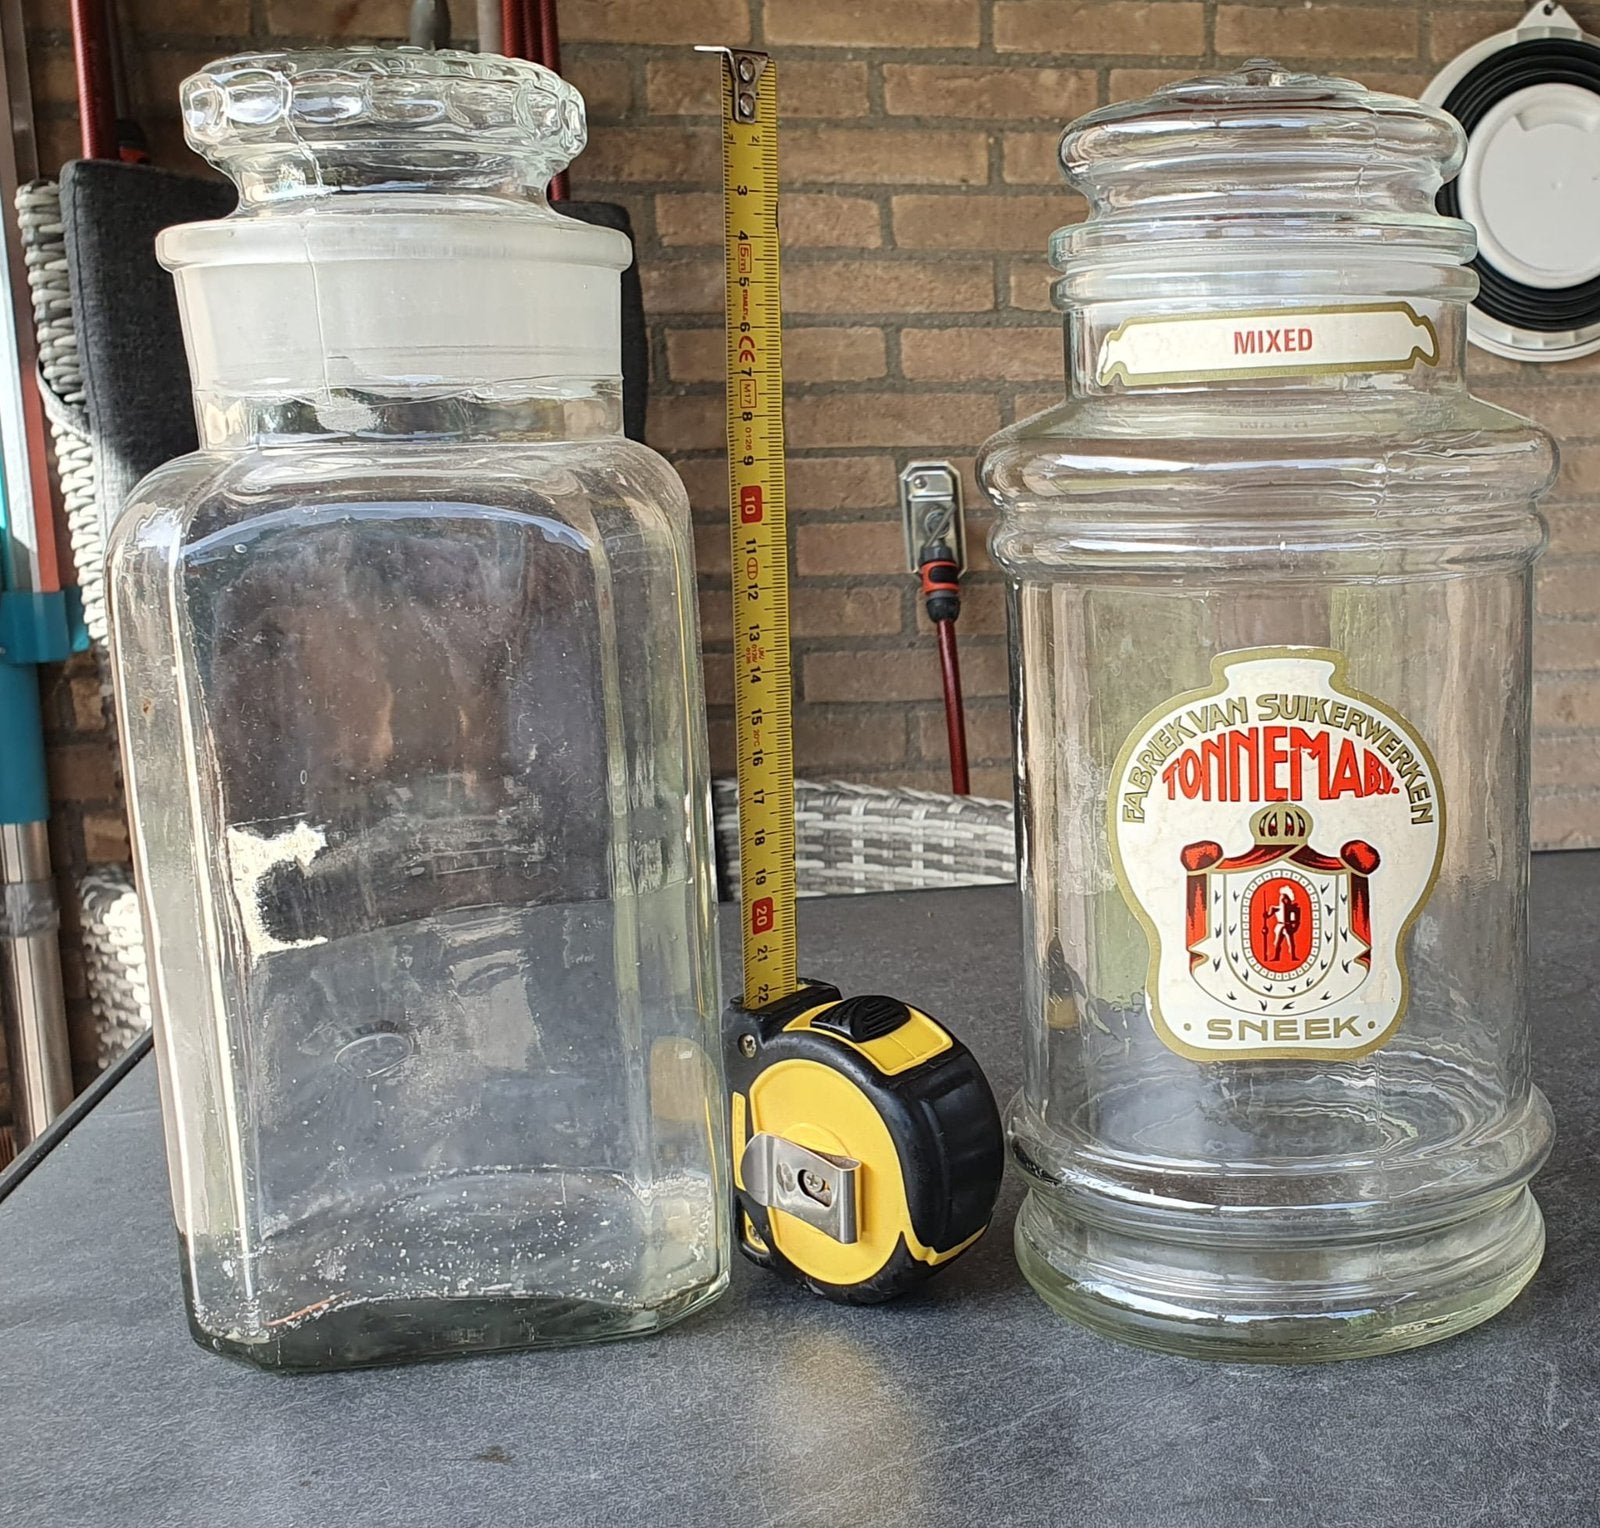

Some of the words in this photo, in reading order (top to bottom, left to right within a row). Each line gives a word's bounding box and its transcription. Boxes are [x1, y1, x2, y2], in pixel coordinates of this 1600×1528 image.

[751, 135, 760, 143] 2
[737, 185, 748, 196] 3
[738, 230, 749, 240] 4
[740, 247, 749, 270] 5m
[739, 277, 750, 287] 5
[740, 322, 751, 332] 6
[1234, 328, 1313, 355] MIXED
[741, 367, 752, 377] 7
[743, 383, 752, 404] M17
[742, 412, 753, 421] 8
[743, 455, 755, 466] 9
[744, 496, 756, 515] 10
[746, 537, 757, 554] 11
[747, 583, 759, 601] 12
[749, 624, 760, 642] 13
[750, 666, 762, 684] 14
[751, 708, 763, 726] 15
[752, 749, 764, 767] 16
[1122, 716, 1197, 823] FABRIEK
[1186, 696, 1249, 734] VAN
[1256, 693, 1434, 825] SUIKERWERKEN
[1162, 726, 1364, 802] TONNEMA
[1363, 747, 1400, 797] B.V.
[754, 789, 765, 804] 17
[754, 828, 766, 846] 18
[755, 868, 767, 886] 19
[756, 905, 768, 927] 20
[757, 945, 768, 962] 21
[758, 984, 769, 1003] 22
[1206, 1015, 1362, 1042] SNEEK
